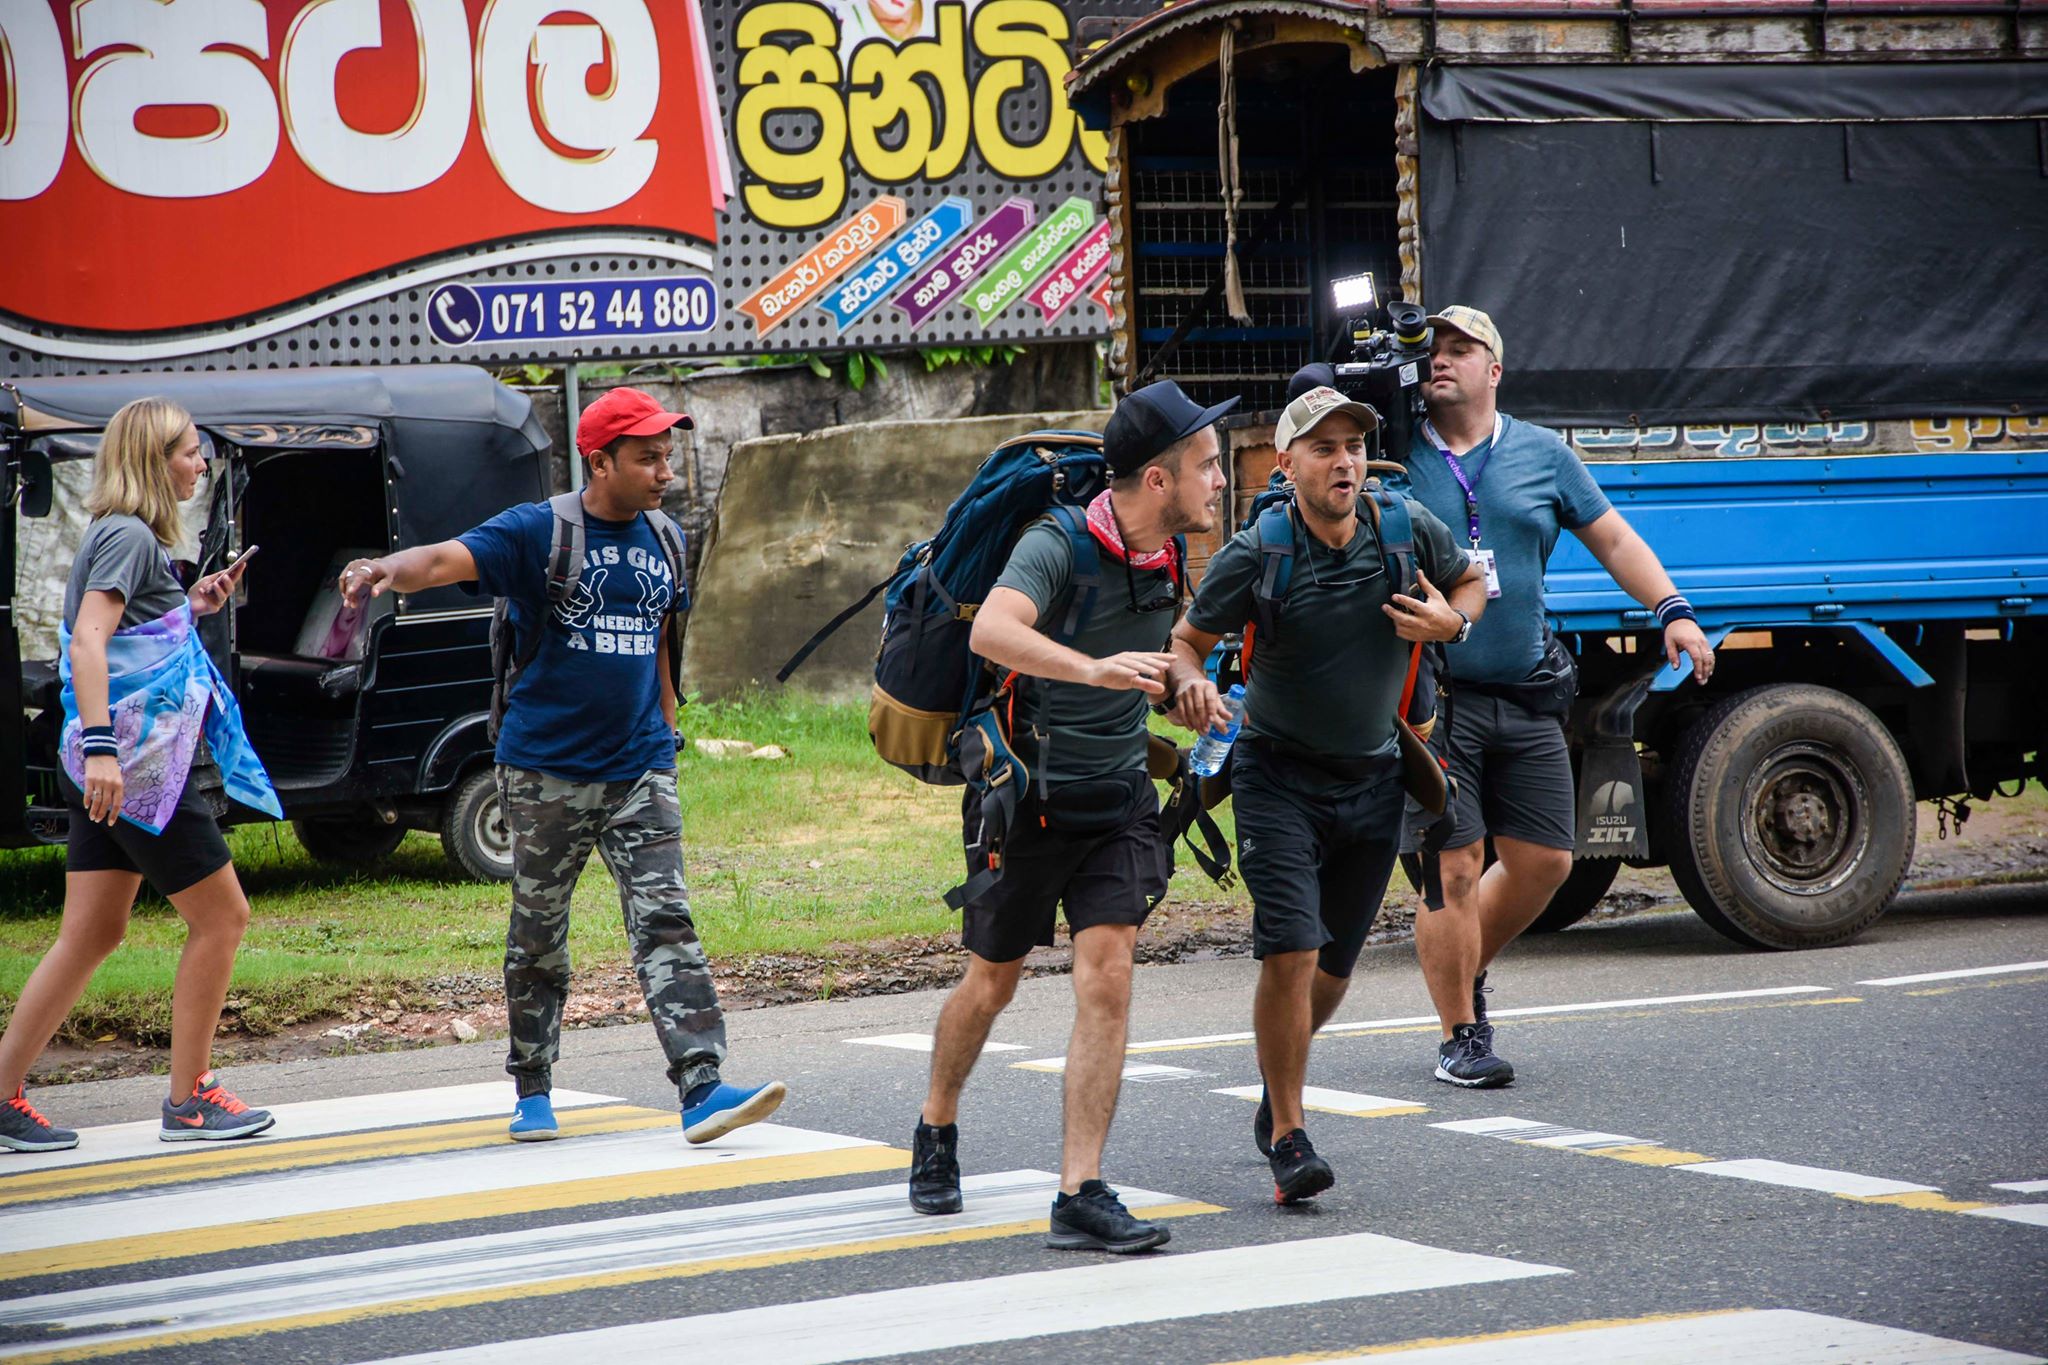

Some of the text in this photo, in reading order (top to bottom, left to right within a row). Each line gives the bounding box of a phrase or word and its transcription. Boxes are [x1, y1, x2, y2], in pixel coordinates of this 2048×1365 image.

[913, 232, 999, 308] නාම පුවරු
[491, 286, 709, 334] 071 52 44 880
[593, 614, 643, 632] NEEDS
[567, 632, 656, 656] A BEER
[1595, 815, 1628, 826] ISUZU
